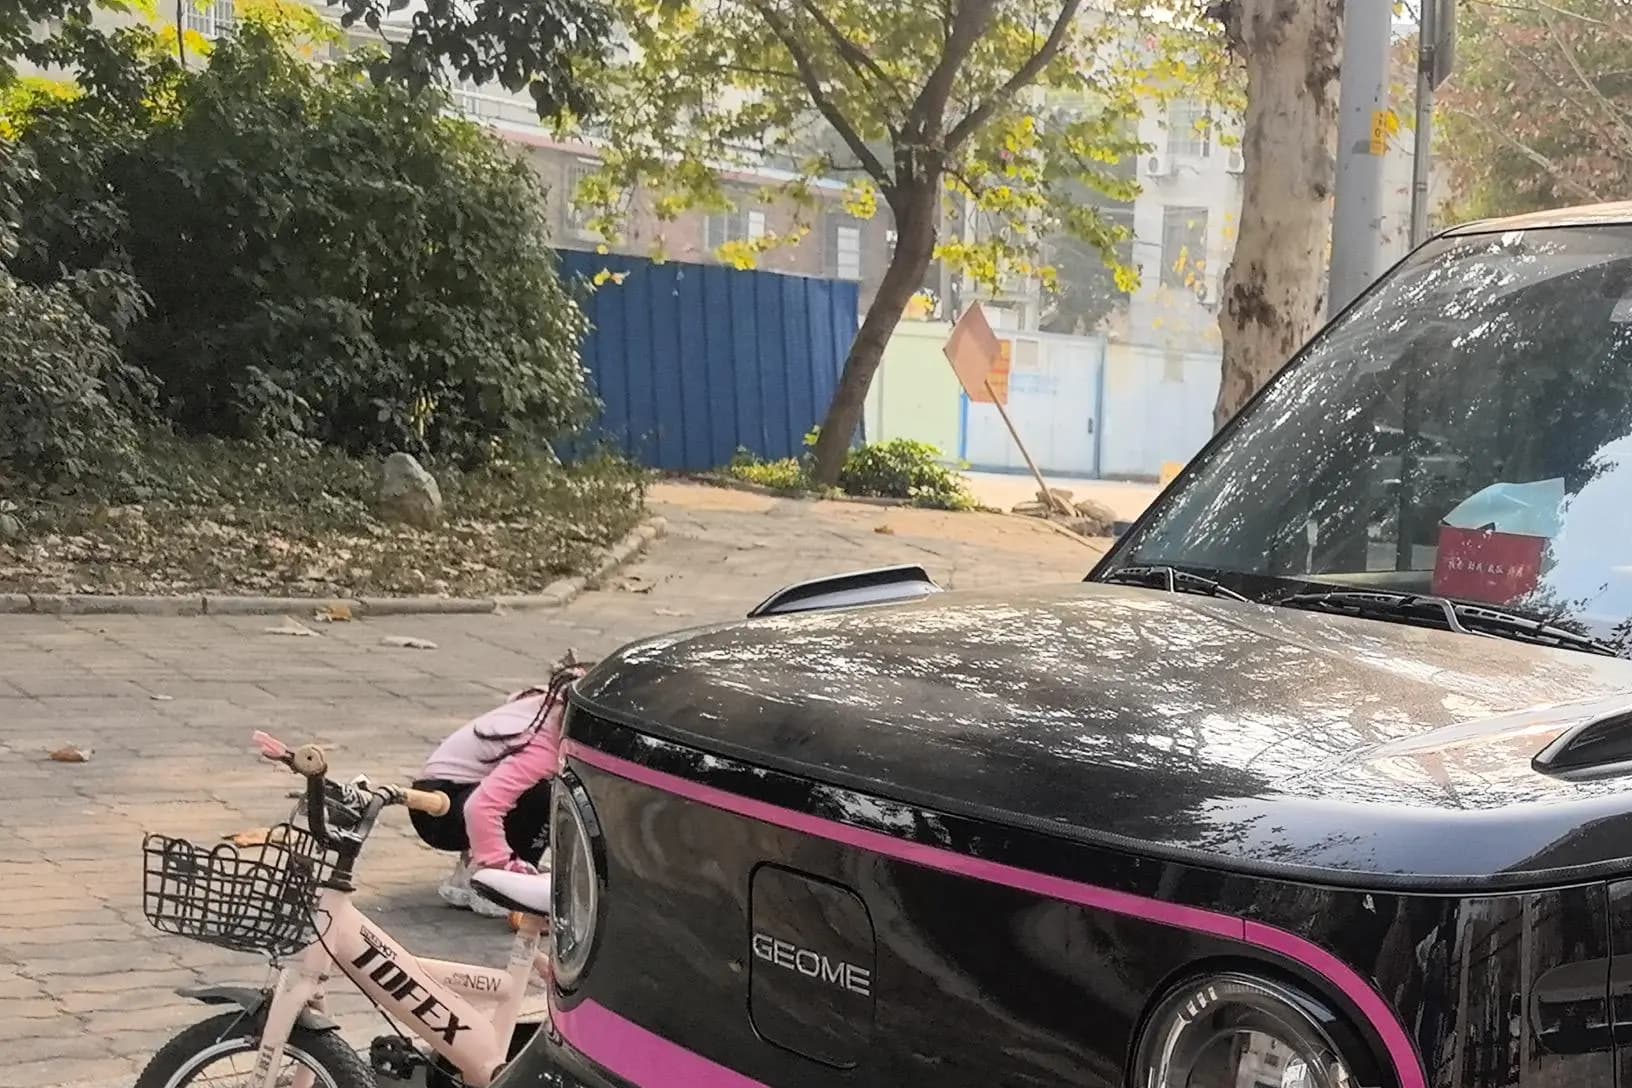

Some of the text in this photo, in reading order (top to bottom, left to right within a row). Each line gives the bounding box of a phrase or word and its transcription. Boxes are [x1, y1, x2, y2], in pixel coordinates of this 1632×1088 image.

[351, 938, 472, 1046] TOFEX
[463, 974, 502, 992] NEW
[752, 932, 870, 996] GEOME
